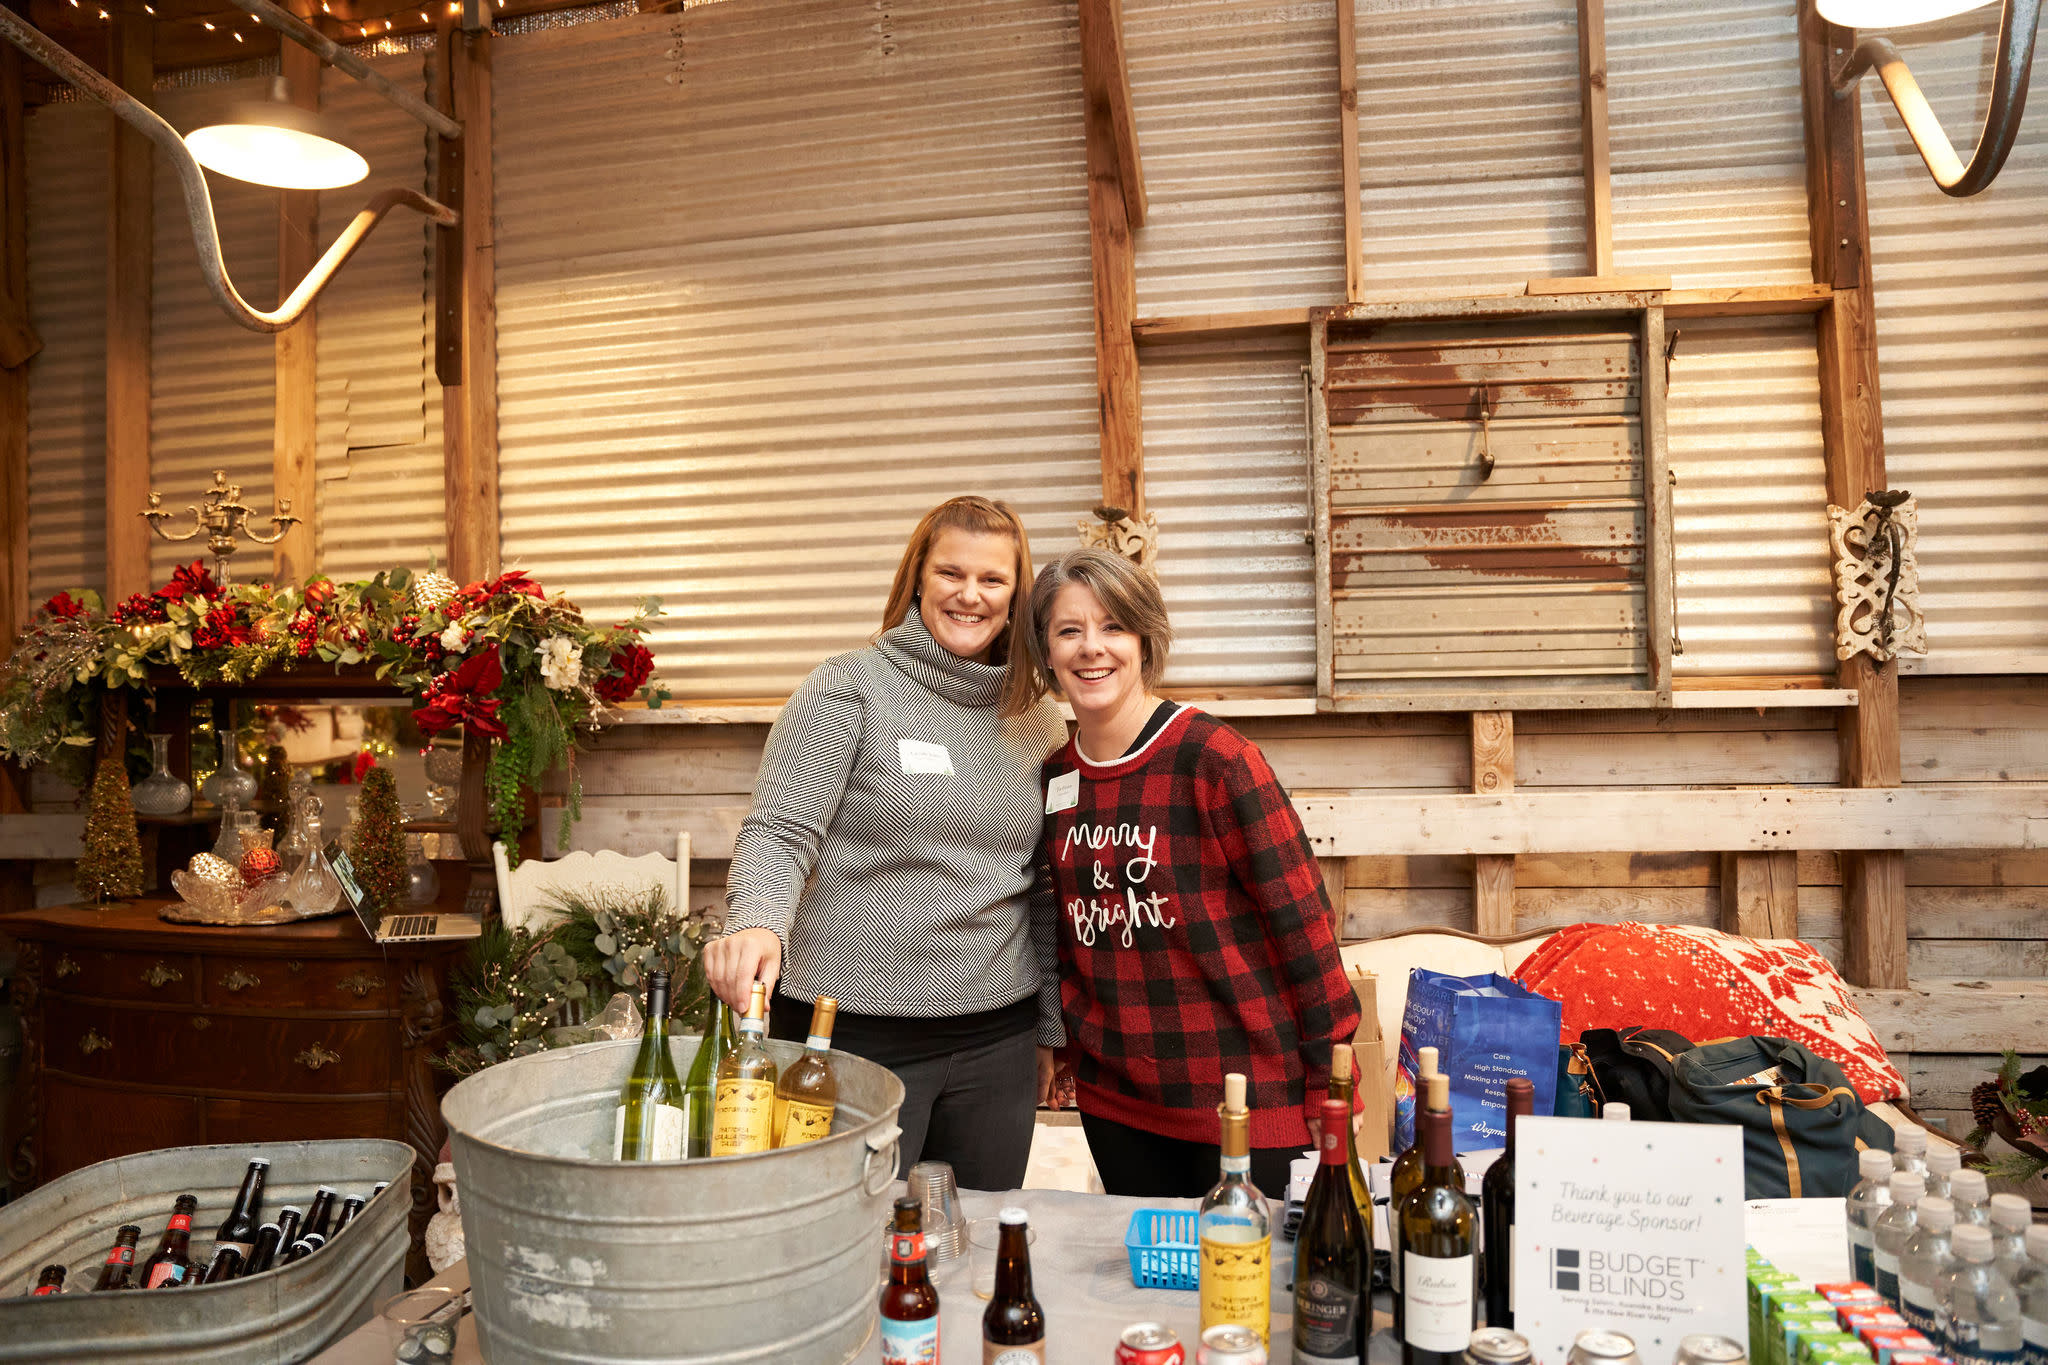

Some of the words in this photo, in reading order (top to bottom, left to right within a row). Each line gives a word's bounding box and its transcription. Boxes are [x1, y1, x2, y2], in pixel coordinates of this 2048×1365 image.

[1093, 860, 1114, 890] &
[1067, 887, 1176, 948] Bright
[1492, 1053, 1511, 1061] Care
[1463, 1073, 1491, 1085] Making
[1474, 1063, 1491, 1072] High
[1492, 1065, 1528, 1076] Standards
[1481, 1099, 1507, 1109] Empow
[1485, 1088, 1507, 1098] Respe
[1470, 1120, 1507, 1139] Wegma
[1559, 1181, 1610, 1202] Thank
[1613, 1191, 1641, 1208] you
[1646, 1188, 1661, 1205] to
[1666, 1193, 1693, 1208] our
[1551, 1203, 1624, 1232] Beverage
[1627, 1208, 1703, 1232] Sponsor!
[1588, 1250, 1700, 1279] BUDGET
[1588, 1273, 1685, 1301] BLINDS
